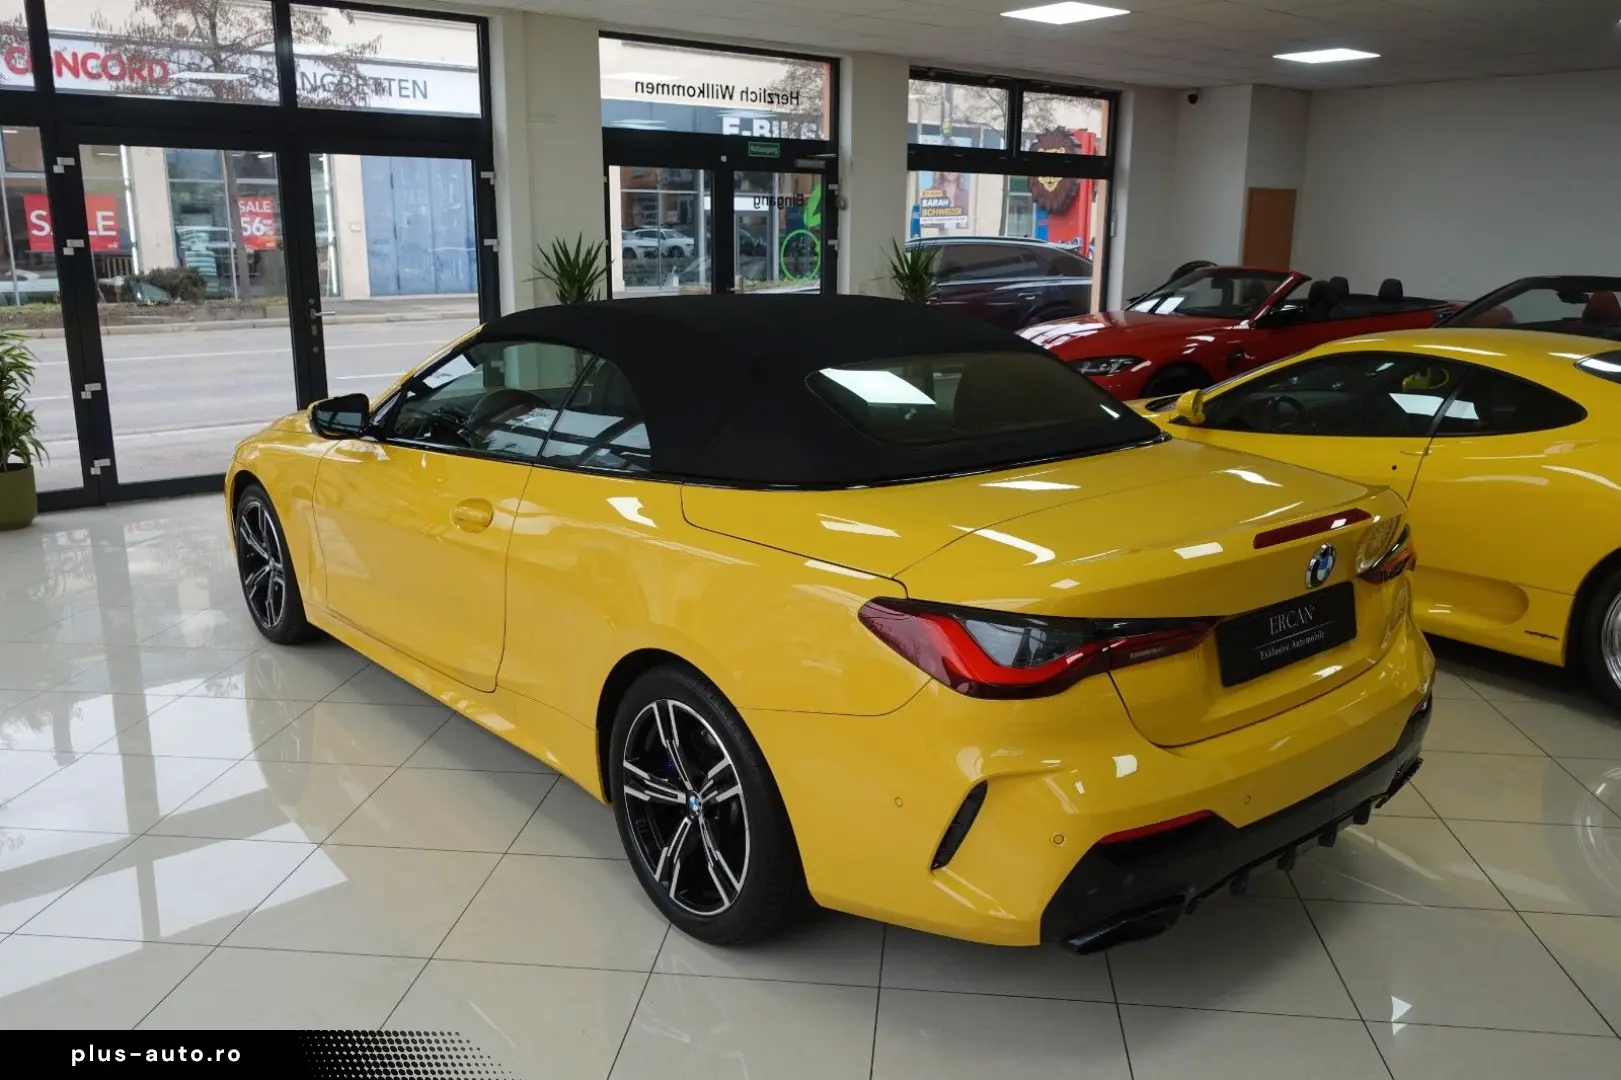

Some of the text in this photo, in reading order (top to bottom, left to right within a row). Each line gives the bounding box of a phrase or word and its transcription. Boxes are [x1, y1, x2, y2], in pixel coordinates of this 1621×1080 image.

[4, 46, 170, 83] CNCORD
[238, 201, 272, 212] SALE
[30, 210, 117, 236] SE
